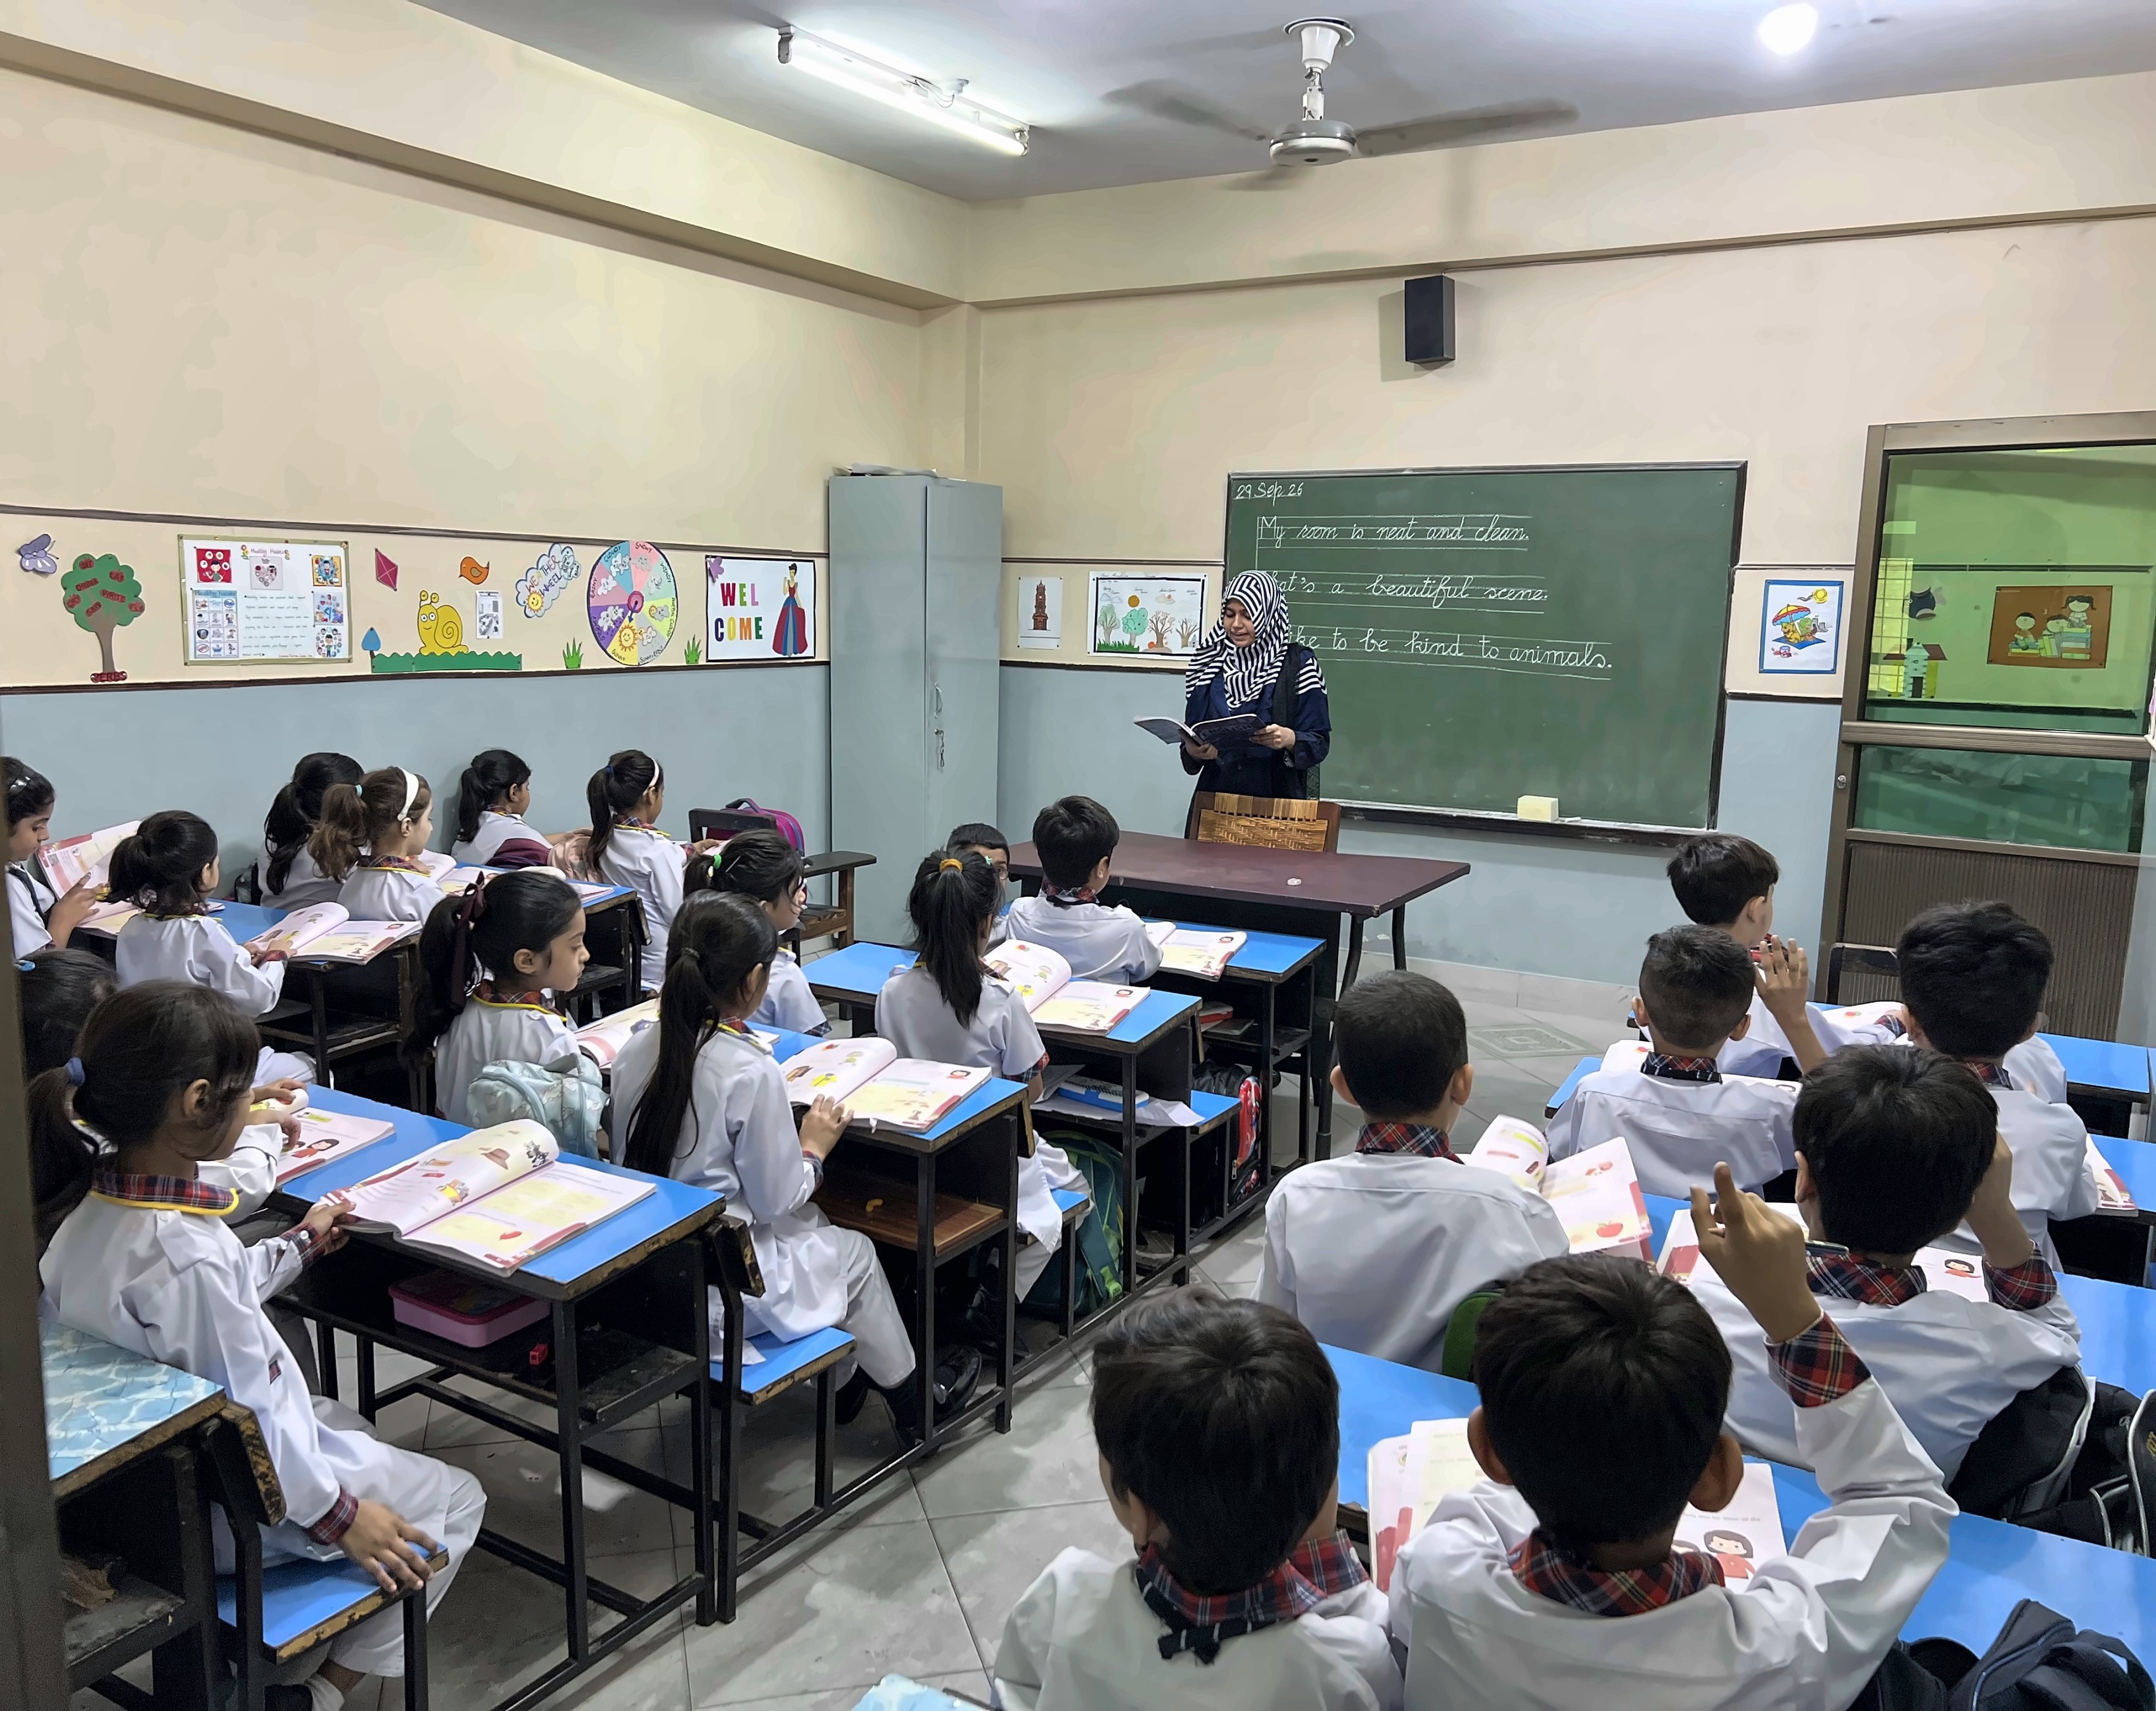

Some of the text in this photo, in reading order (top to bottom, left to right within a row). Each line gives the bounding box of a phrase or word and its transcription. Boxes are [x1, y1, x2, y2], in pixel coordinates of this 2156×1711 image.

[1235, 480, 1304, 506] 29 Sep 26
[1261, 514, 1529, 549] My room is neat and clean.
[604, 545, 622, 562] CLOUDY
[635, 542, 652, 553] SNOWY
[539, 572, 563, 596] WHEEL
[660, 562, 671, 583] WINDY
[721, 583, 759, 606] WEL
[1272, 570, 1548, 608] at's a beautiful scene.
[714, 617, 763, 642] COME
[1288, 624, 1613, 669] ike to be kind to animals.
